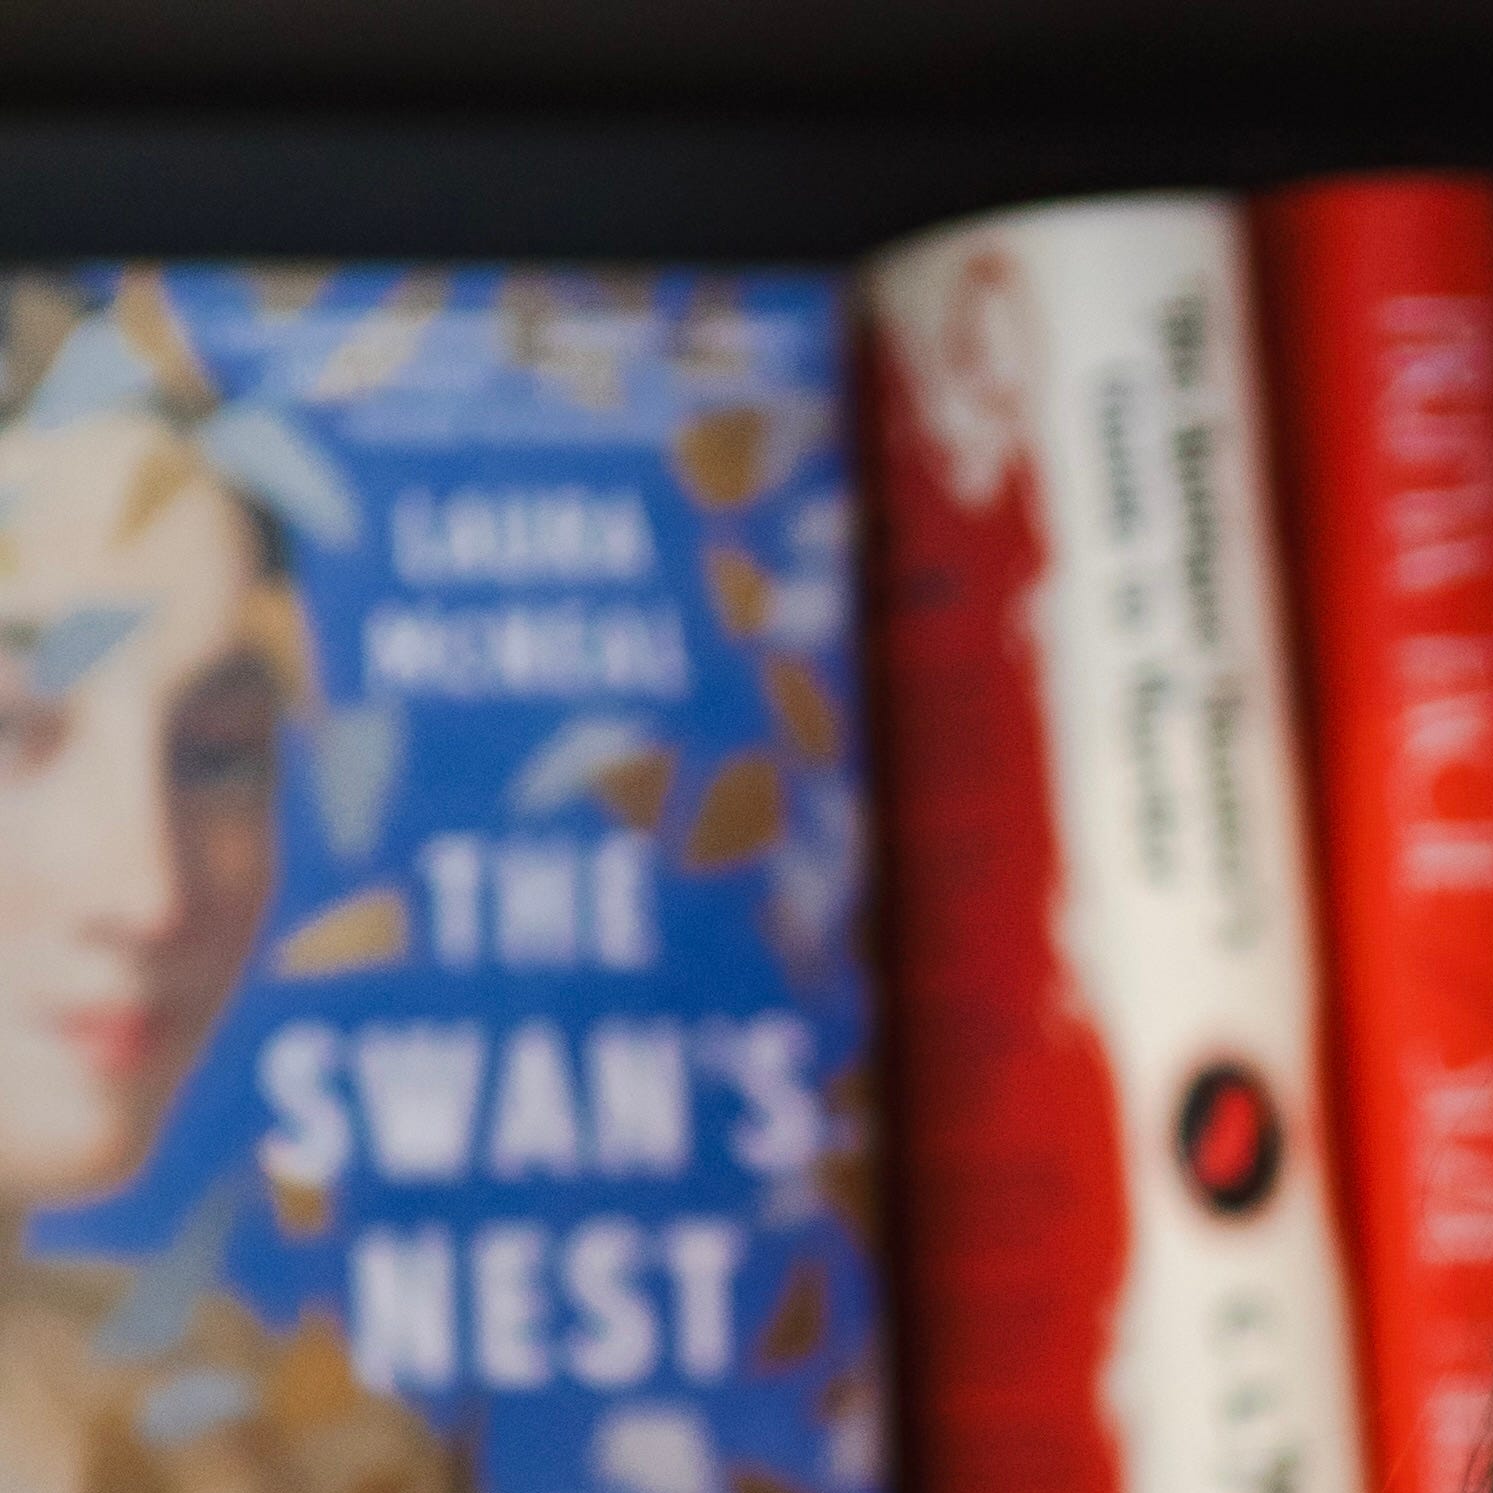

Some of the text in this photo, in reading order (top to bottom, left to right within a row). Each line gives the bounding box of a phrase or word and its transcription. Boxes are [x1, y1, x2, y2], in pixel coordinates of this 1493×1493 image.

[394, 487, 654, 583] LAURA
[420, 830, 660, 968] THE
[260, 1018, 824, 1186] SWAN'S
[350, 1216, 742, 1392] NEST
